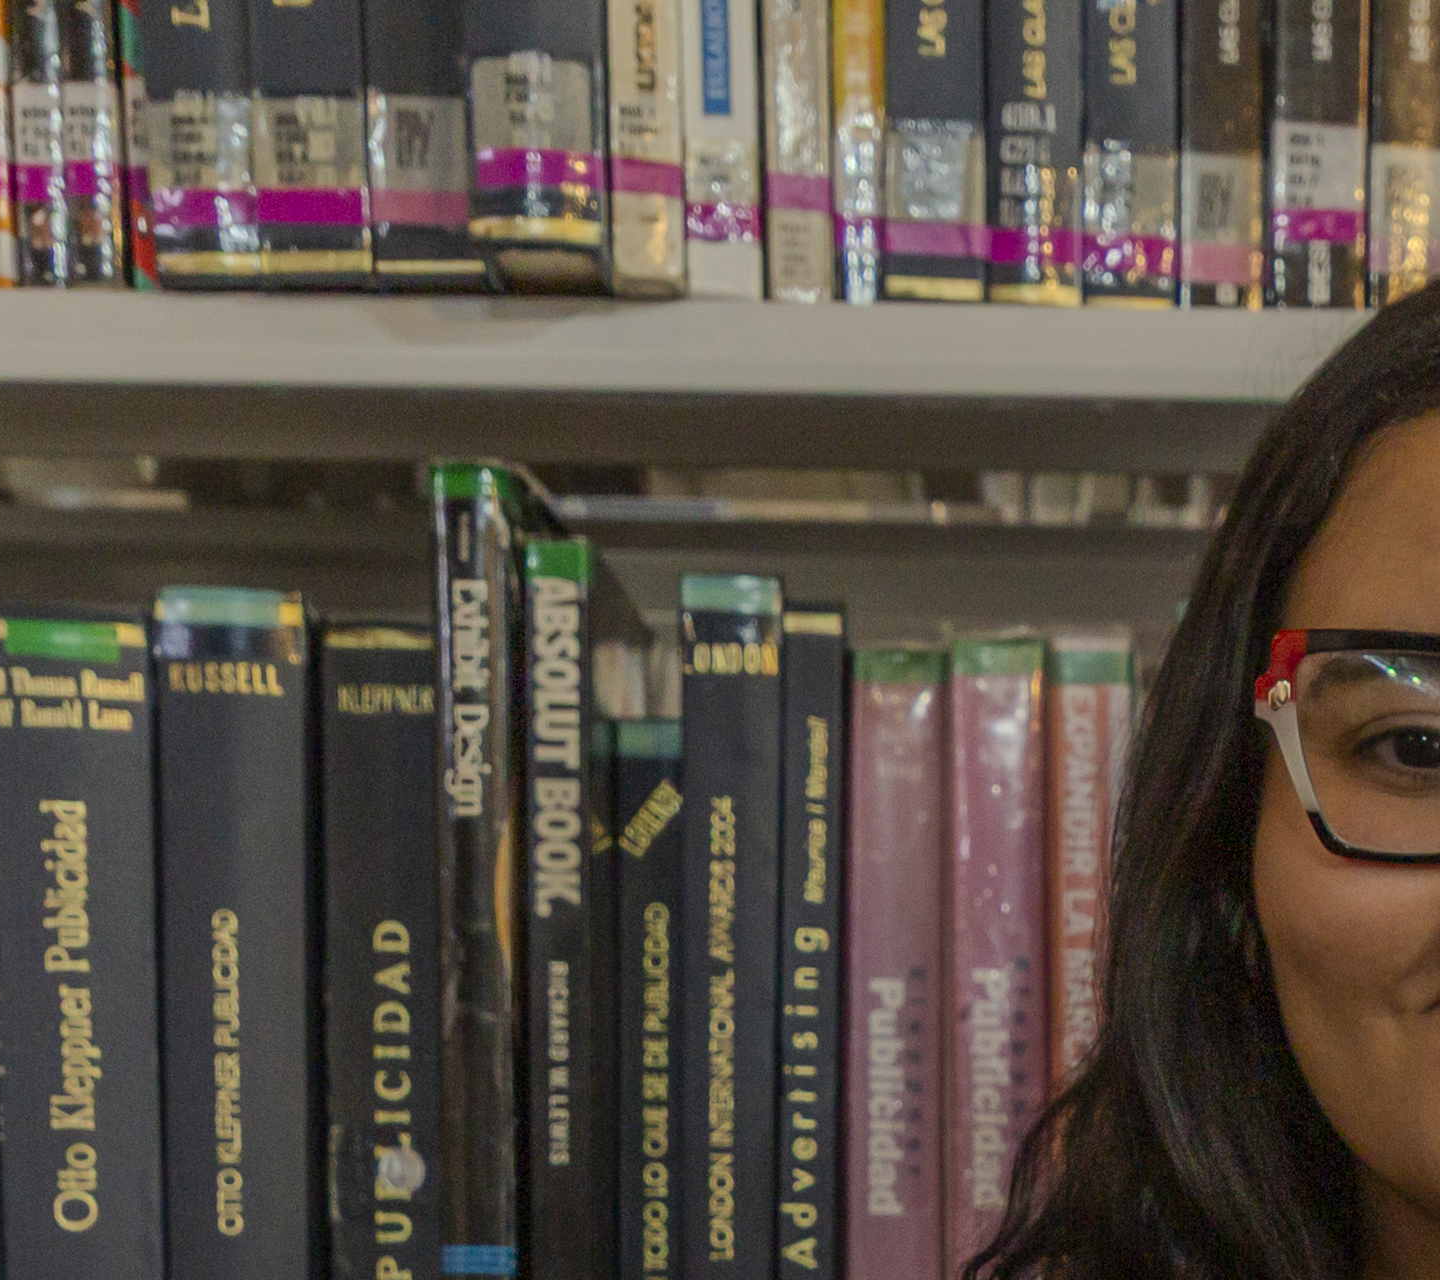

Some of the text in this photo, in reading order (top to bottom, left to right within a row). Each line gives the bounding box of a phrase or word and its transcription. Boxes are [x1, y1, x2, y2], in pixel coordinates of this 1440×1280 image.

[532, 577, 581, 769] ABSOLUT
[693, 642, 779, 676] ONDON
[39, 797, 92, 975] Publicidad
[866, 977, 905, 1216] Publicidad
